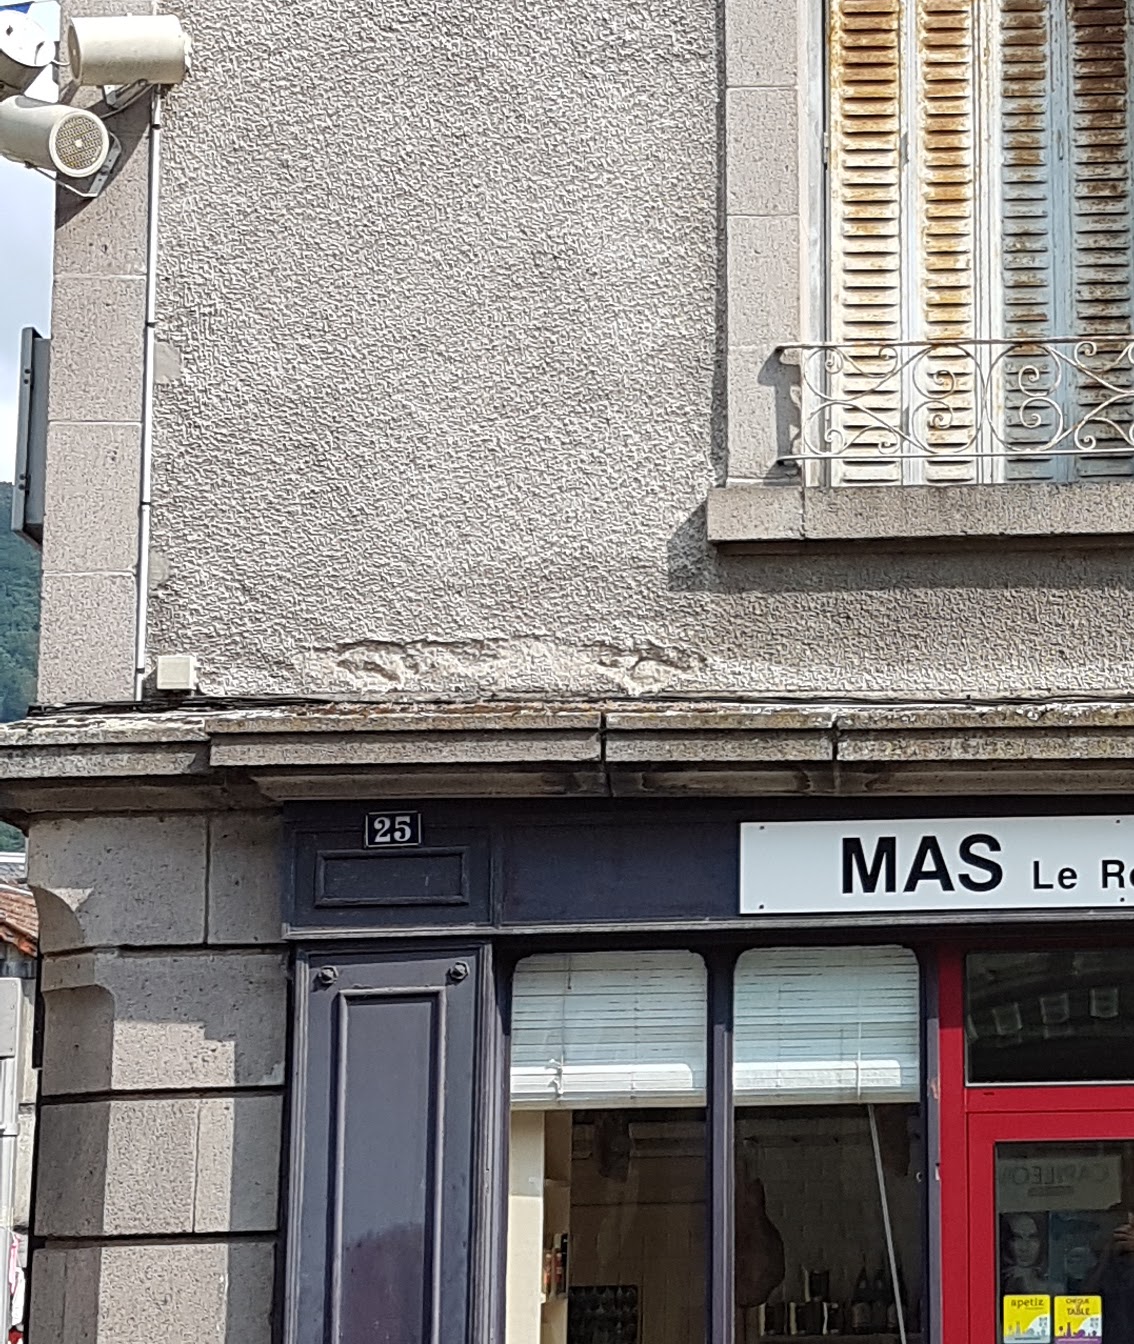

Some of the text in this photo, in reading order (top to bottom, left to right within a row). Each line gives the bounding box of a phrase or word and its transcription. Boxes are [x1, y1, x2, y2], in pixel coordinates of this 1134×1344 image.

[373, 816, 411, 843] 25
[841, 833, 1002, 894] MAS
[1032, 859, 1078, 890] Le
